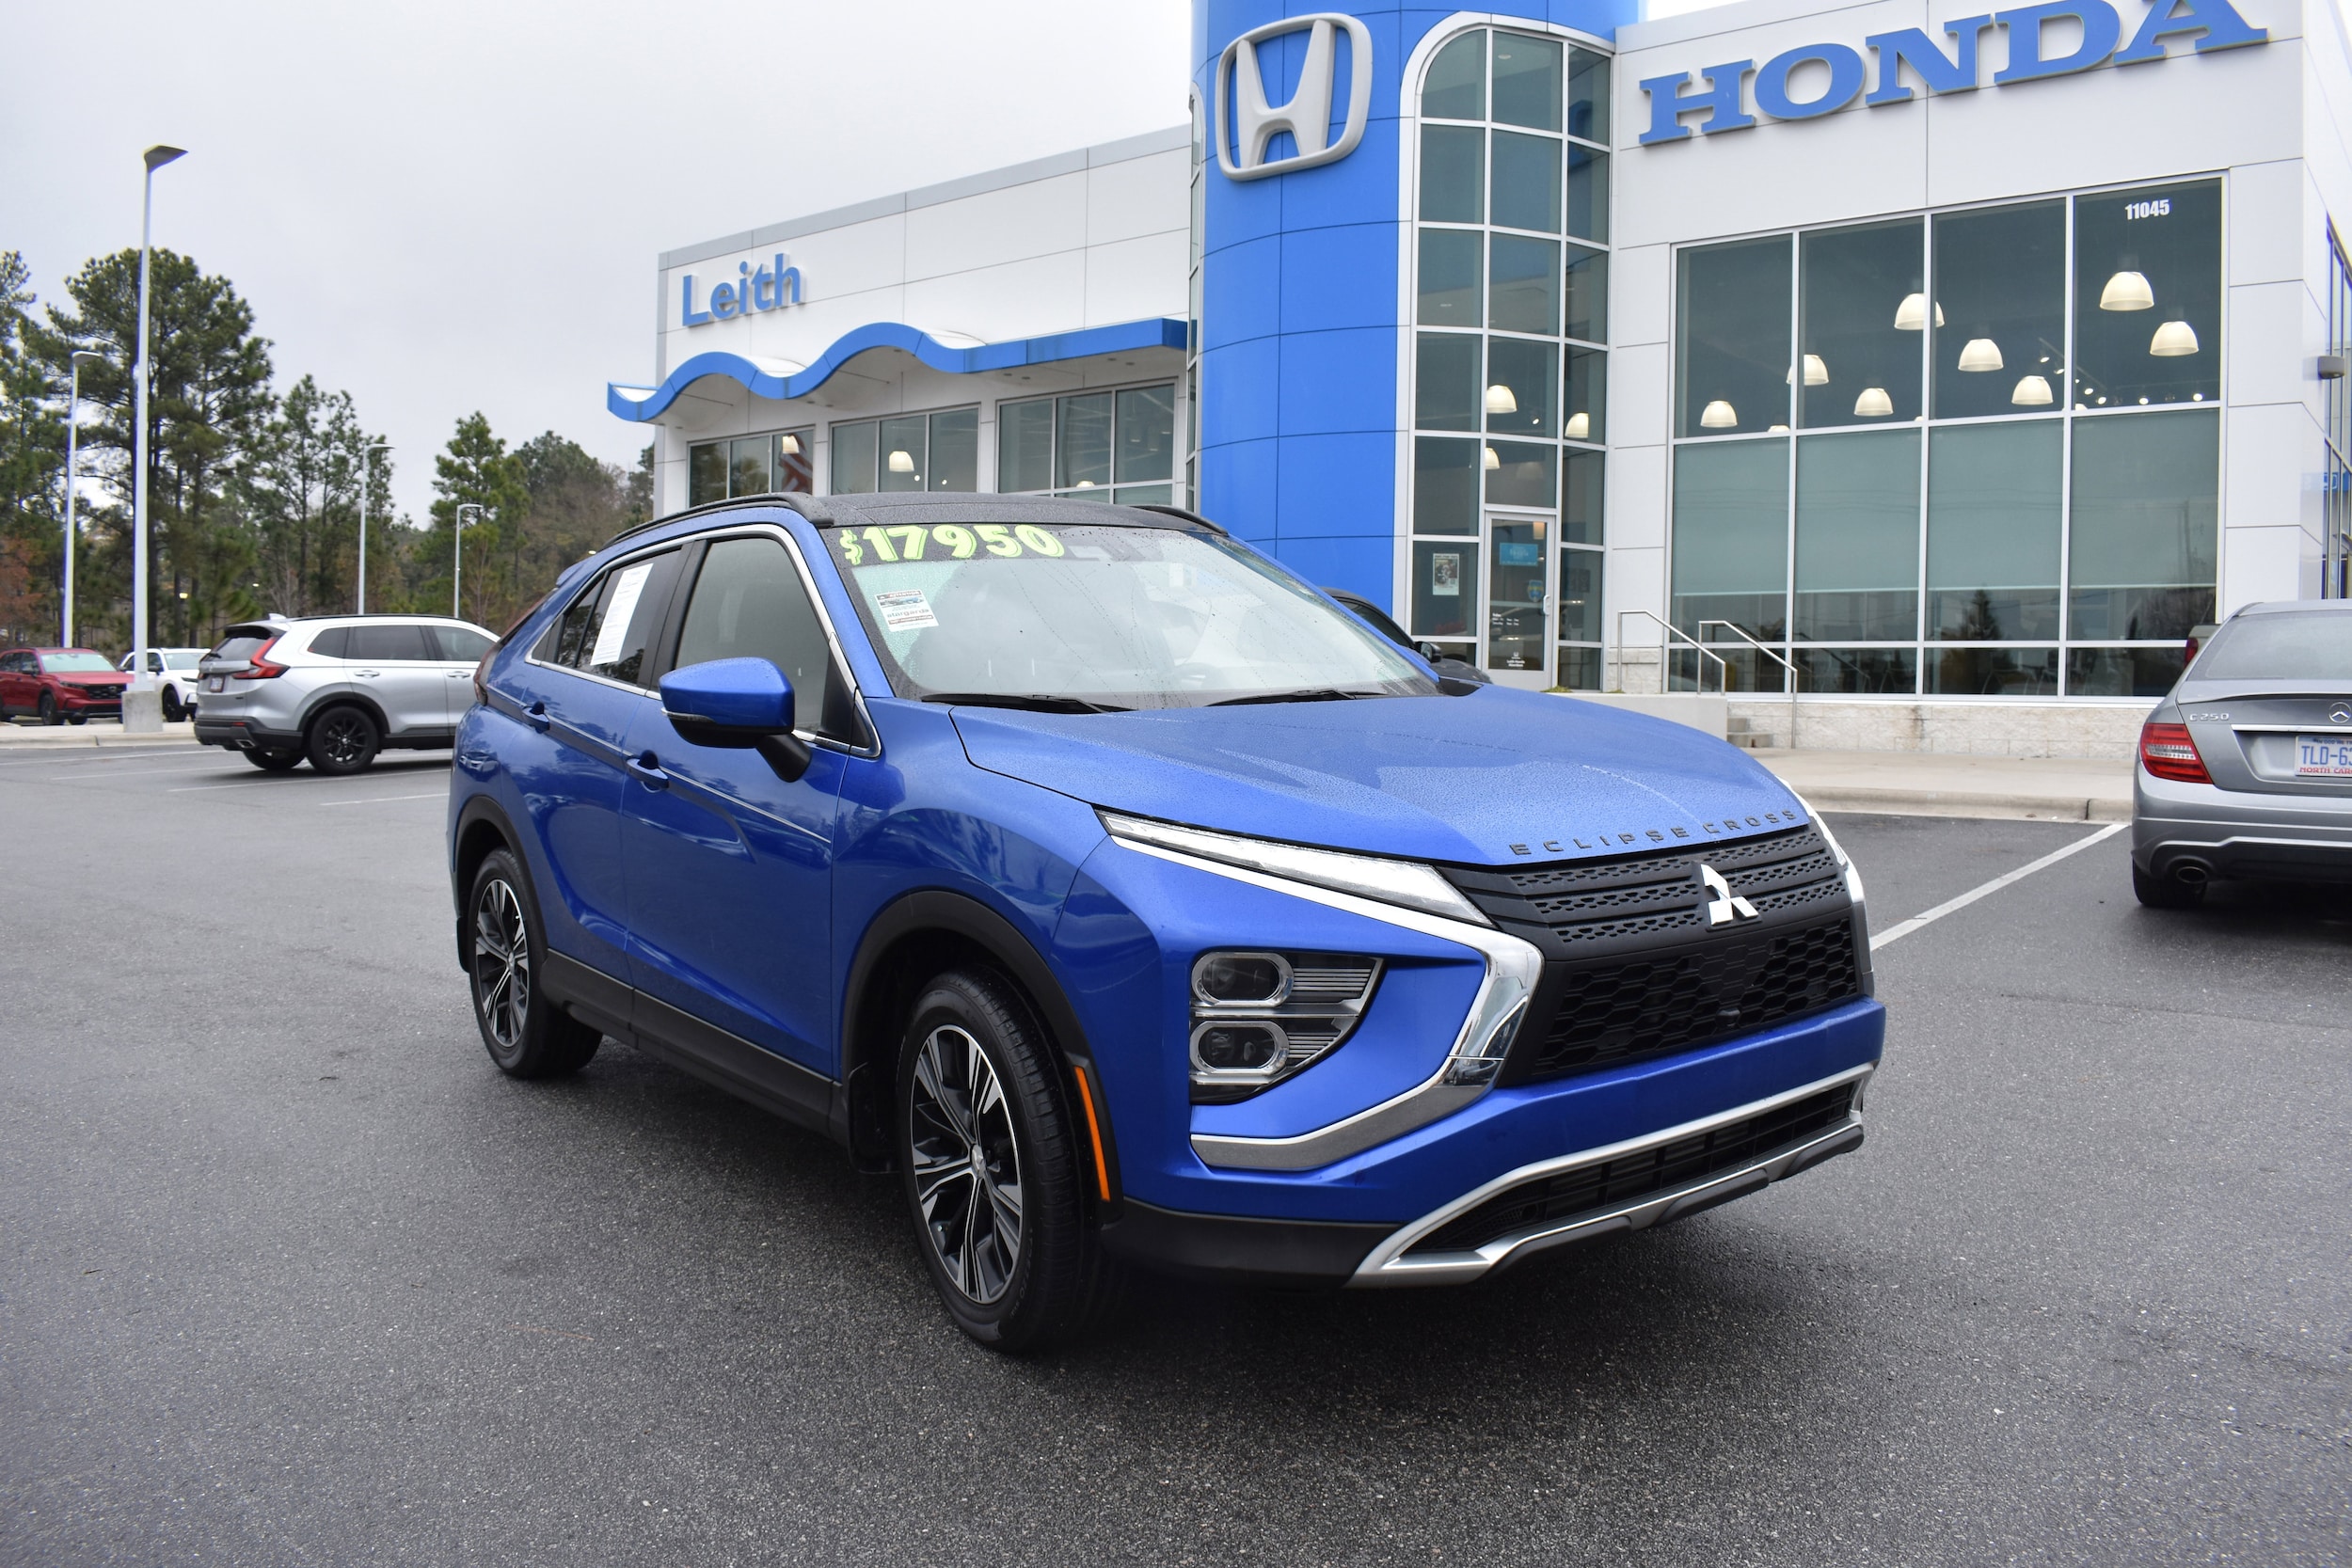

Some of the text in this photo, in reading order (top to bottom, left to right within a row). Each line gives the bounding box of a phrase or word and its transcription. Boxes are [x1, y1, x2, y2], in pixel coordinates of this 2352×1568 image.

[1638, 0, 2269, 146] HONDA
[2124, 198, 2170, 220] 11045
[682, 253, 803, 327] Leith
[839, 524, 1065, 565] $17950
[2189, 713, 2230, 721] C 250
[1509, 809, 1797, 856] ECLIPSE CROSS
